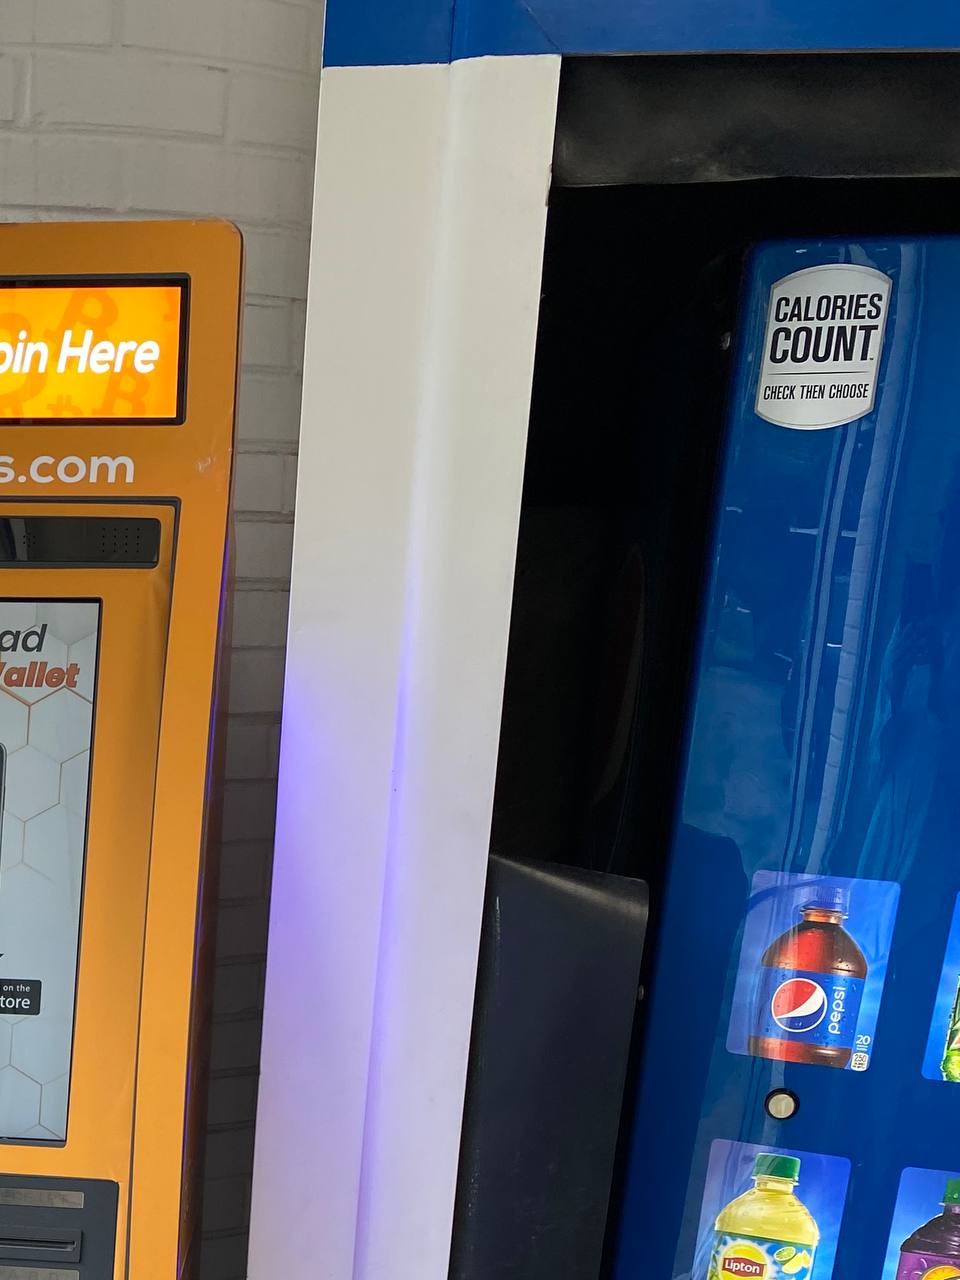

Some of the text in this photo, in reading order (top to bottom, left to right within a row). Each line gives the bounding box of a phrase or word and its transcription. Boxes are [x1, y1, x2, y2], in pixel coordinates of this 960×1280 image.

[775, 293, 882, 322] CALORIES
[57, 330, 159, 374] Here
[763, 383, 869, 400] CHECK THEN CHOOSE
[16, 984, 31, 993] the
[827, 985, 847, 1035] pepsi
[855, 1034, 871, 1045] 20
[724, 1259, 760, 1274] Lipton
